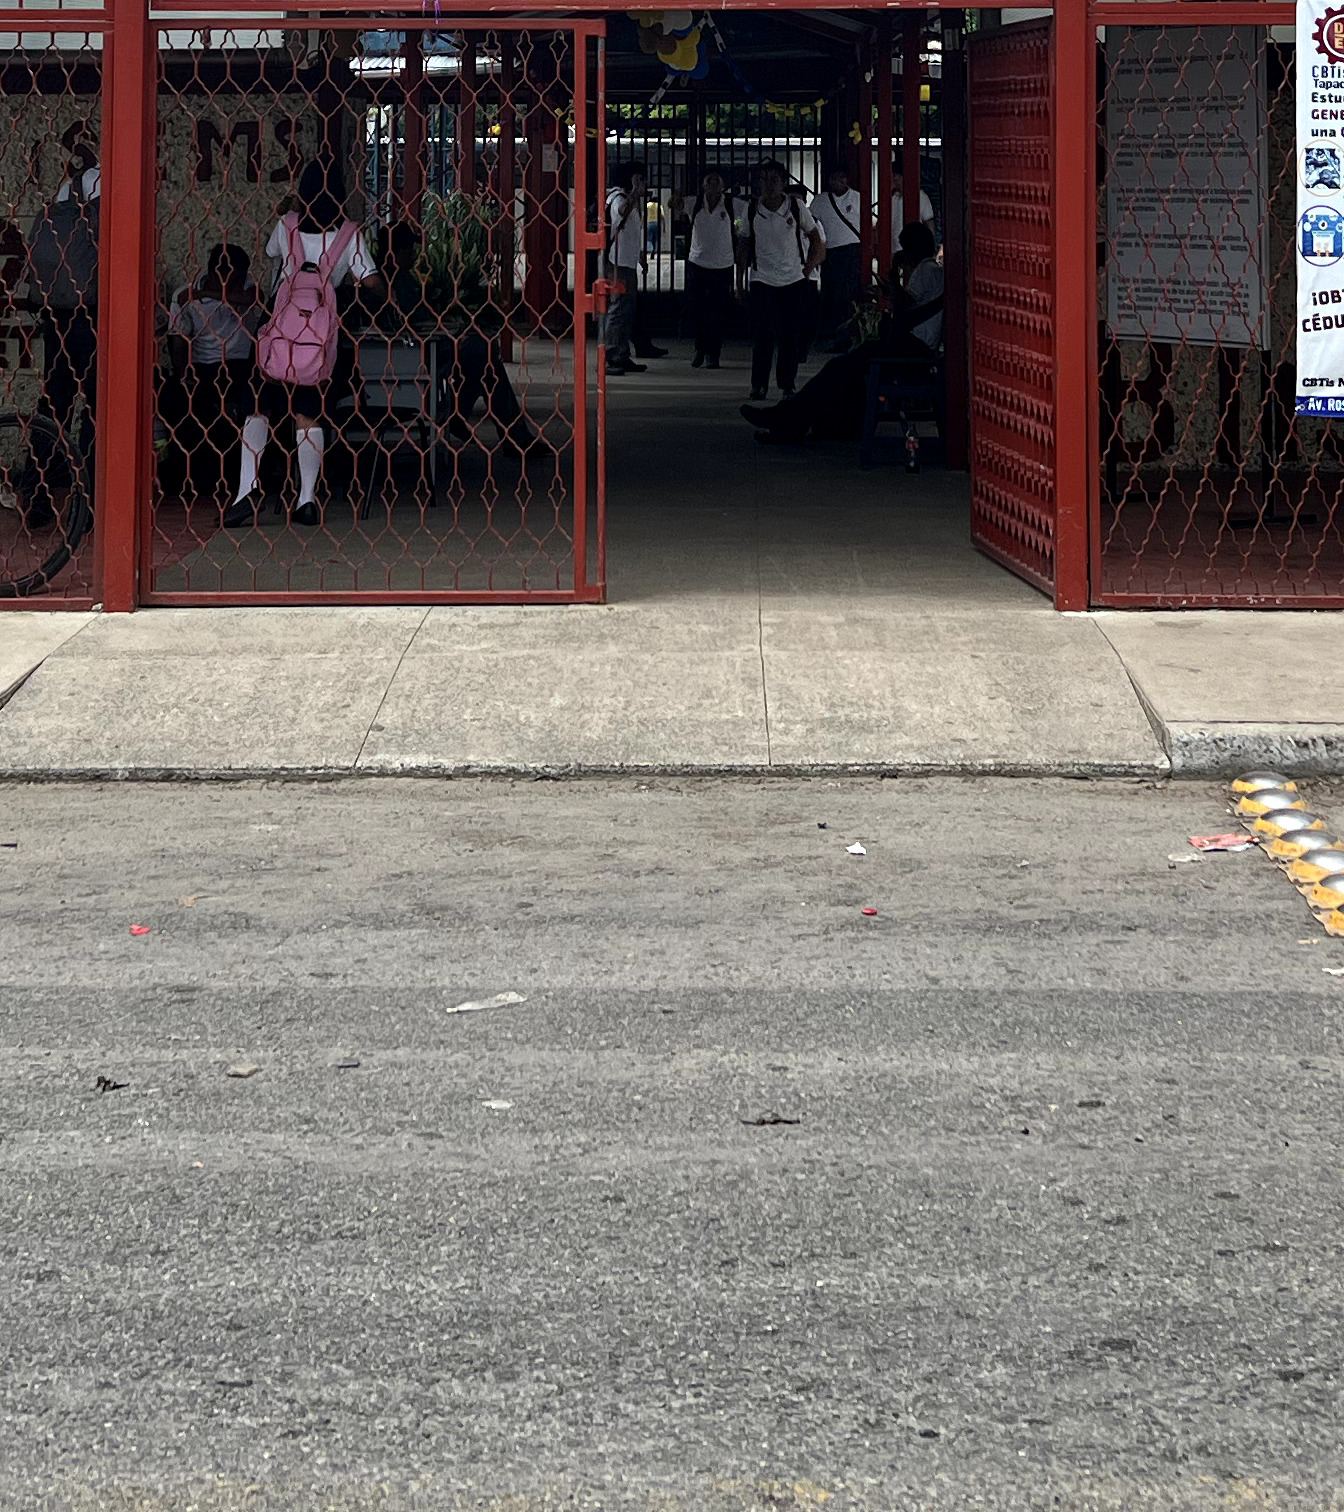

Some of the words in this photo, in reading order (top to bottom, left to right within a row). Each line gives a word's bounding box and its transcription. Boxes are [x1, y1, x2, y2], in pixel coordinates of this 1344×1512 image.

[1311, 128, 1337, 138] una
[1302, 377, 1334, 387] CBTis
[1308, 398, 1326, 411] Av.
